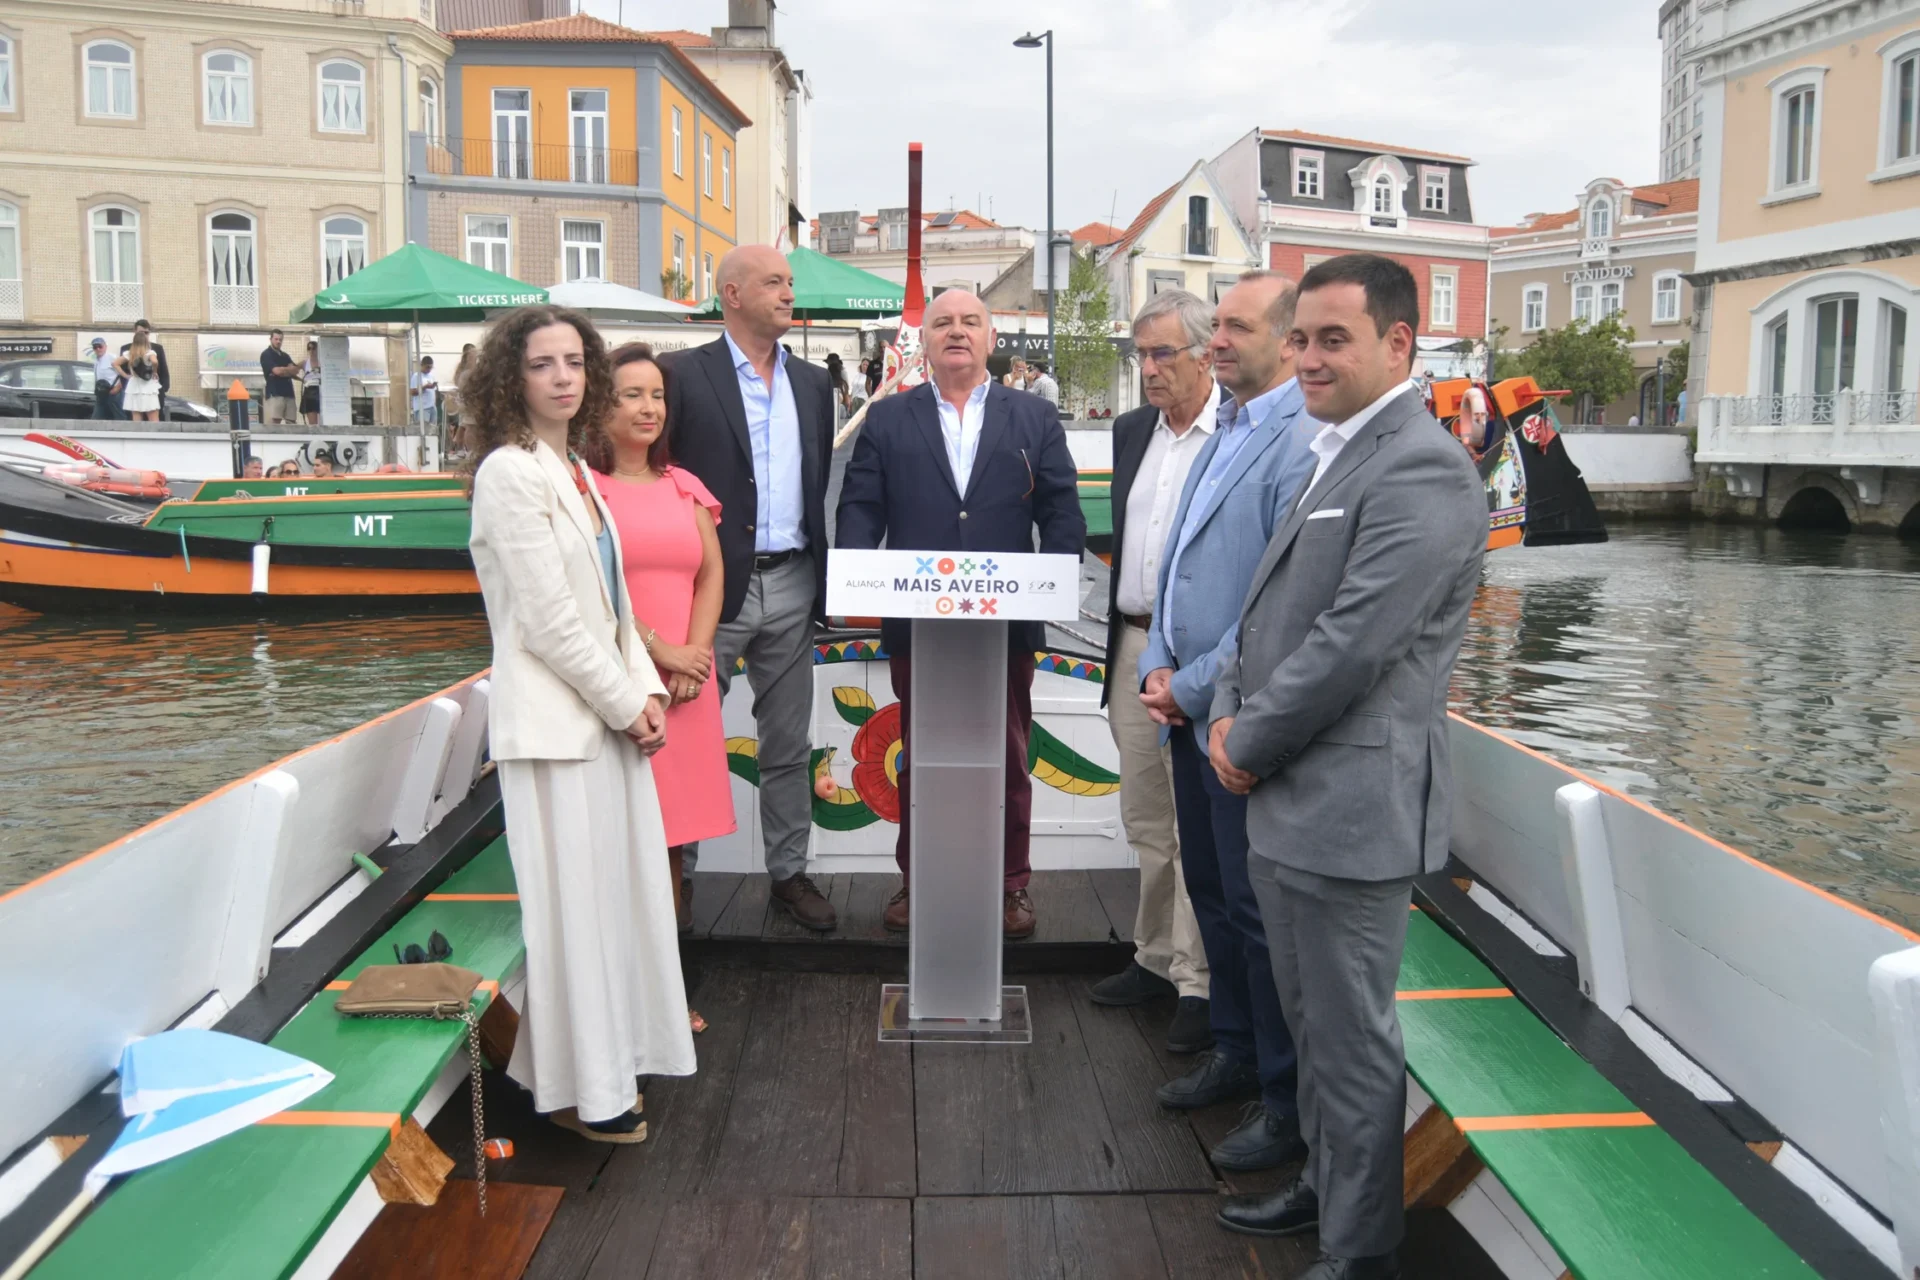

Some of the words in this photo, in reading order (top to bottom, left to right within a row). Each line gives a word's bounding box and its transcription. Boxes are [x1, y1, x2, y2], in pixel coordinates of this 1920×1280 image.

[457, 294, 508, 305] TICKETS
[510, 293, 543, 304] HERE
[846, 298, 893, 309] TICKETS
[284, 486, 309, 497] MT
[354, 514, 394, 537] MT
[846, 579, 886, 590] ALIANÇA
[893, 577, 943, 592] MAIS
[947, 578, 1020, 594] AVEIRO
